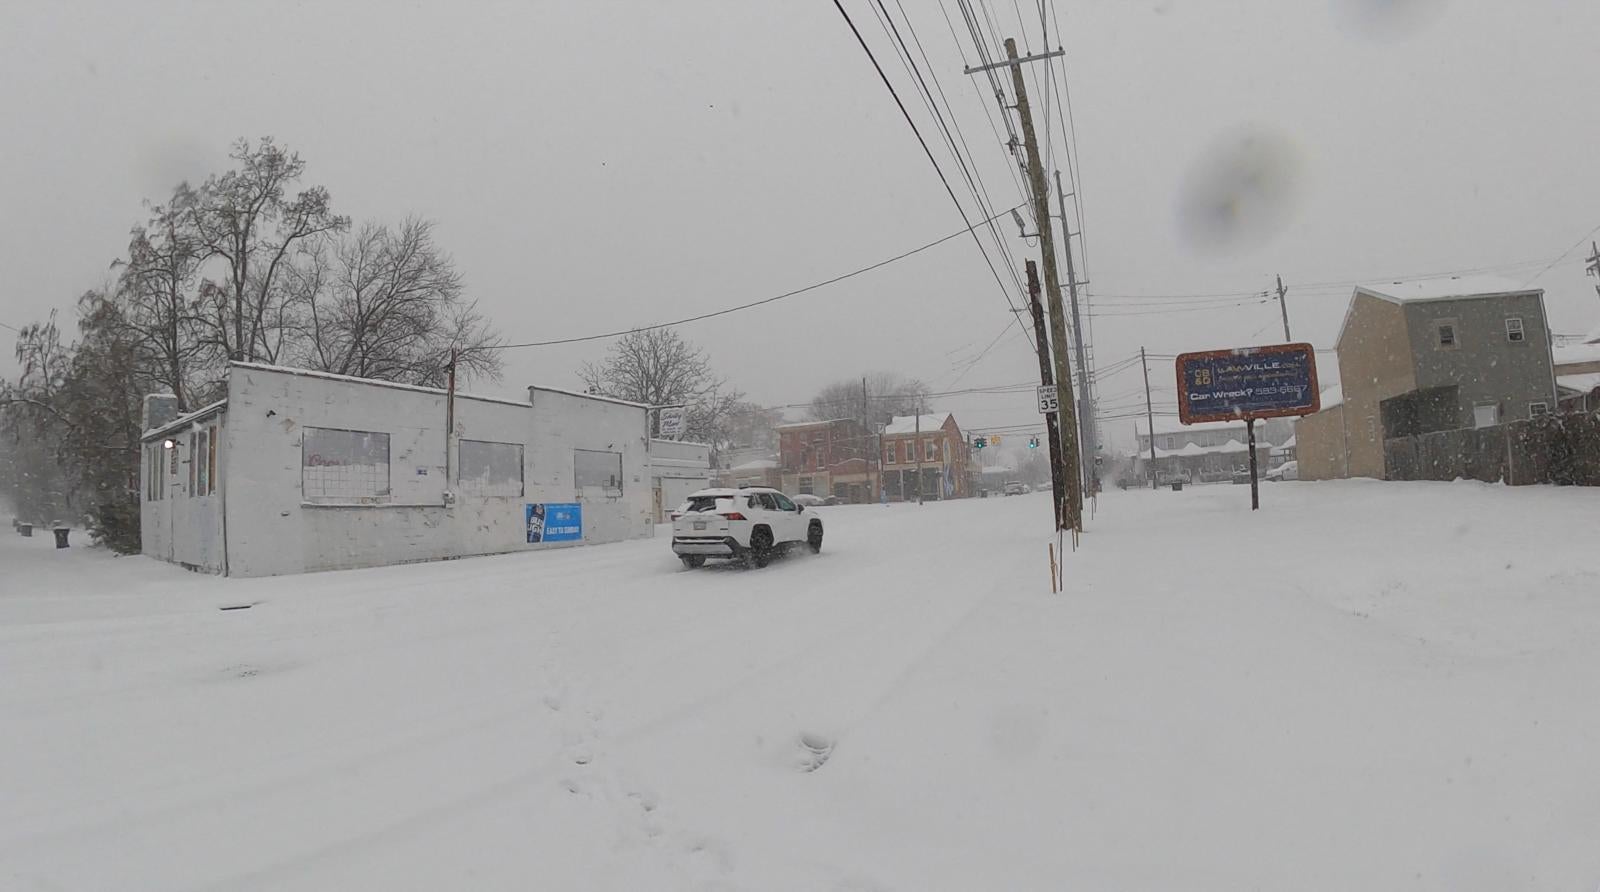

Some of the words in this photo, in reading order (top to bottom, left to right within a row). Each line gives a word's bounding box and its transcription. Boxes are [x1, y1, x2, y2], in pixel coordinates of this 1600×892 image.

[1190, 393, 1211, 401] Car
[1212, 388, 1253, 399] Wreck?
[1041, 399, 1057, 409] 35
